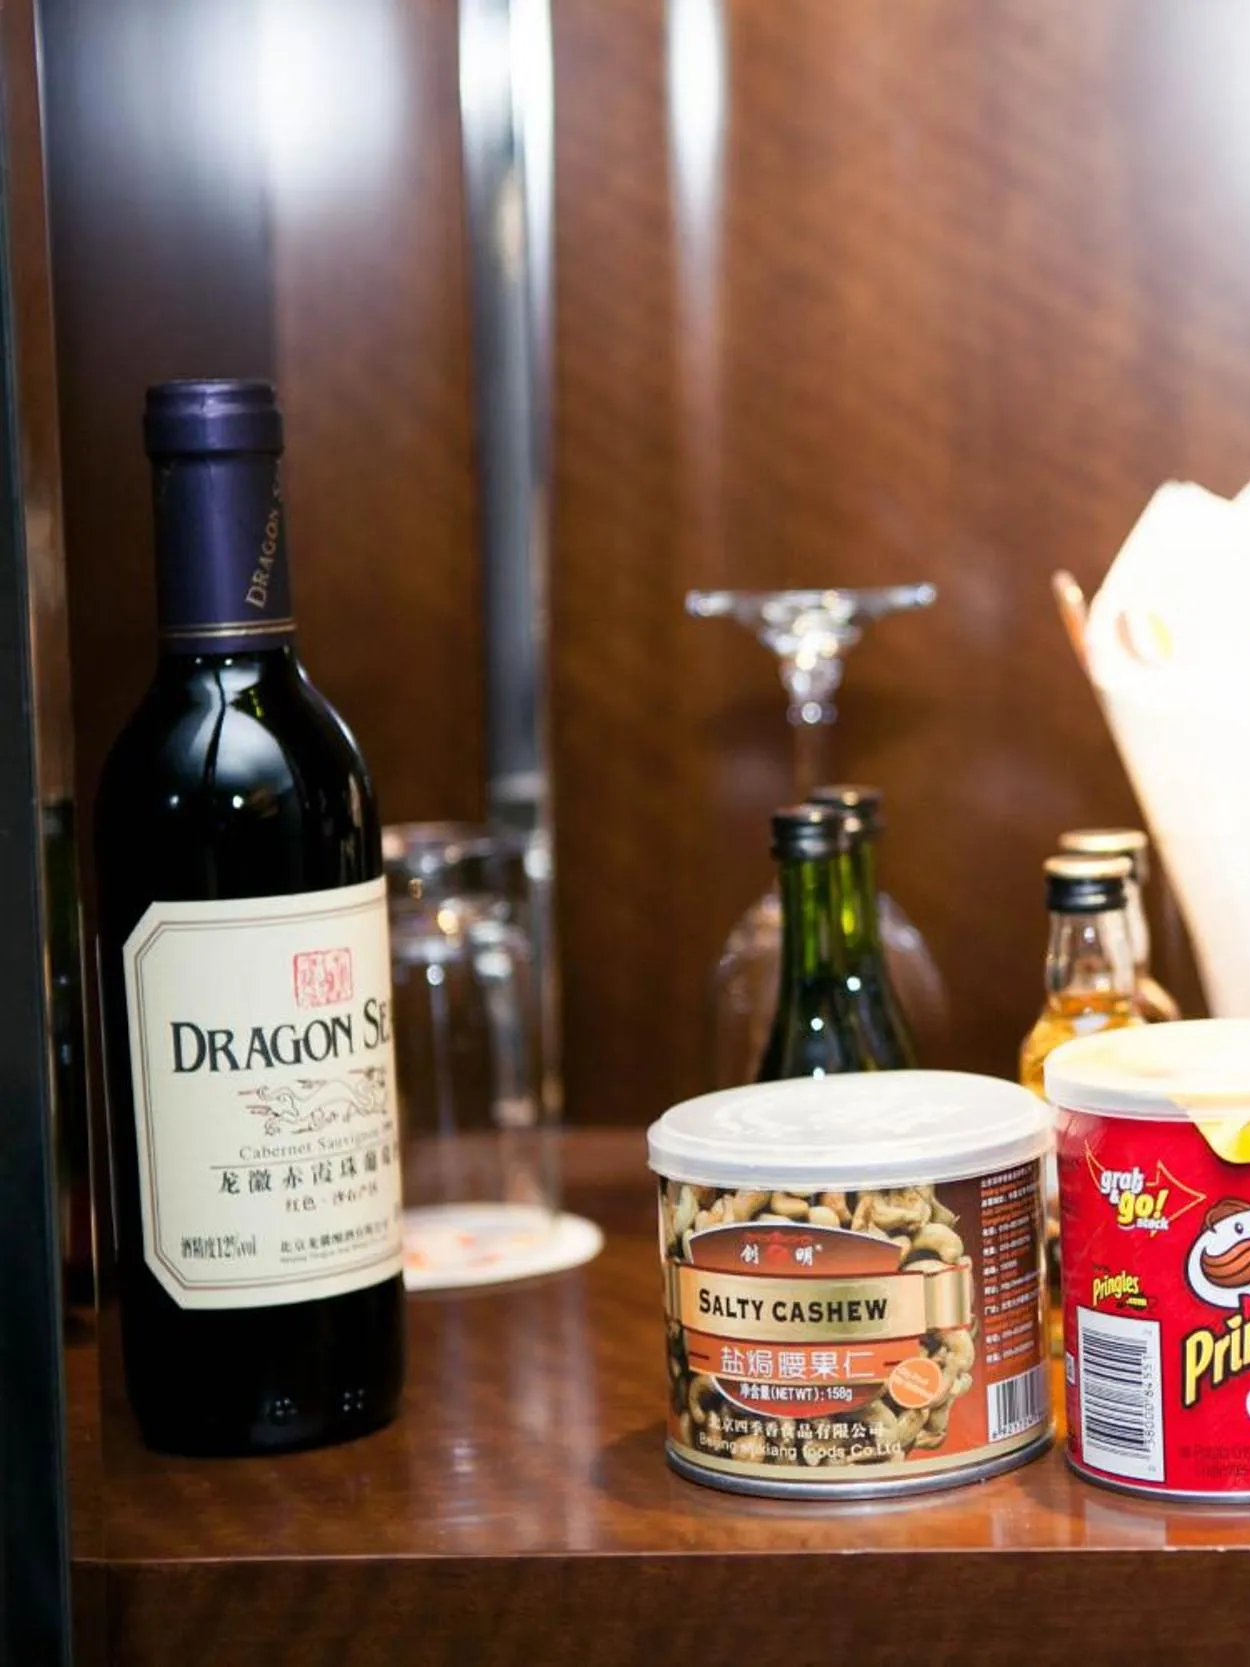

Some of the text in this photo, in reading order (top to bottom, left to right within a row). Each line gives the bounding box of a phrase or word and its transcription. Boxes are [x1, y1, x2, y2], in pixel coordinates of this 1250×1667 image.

[244, 509, 279, 609] DRAGON
[170, 1013, 353, 1074] DRAGON
[239, 1140, 312, 1160] Cabernet
[219, 1142, 399, 1195] 龙徽赤霞珠葡萄
[1100, 1166, 1145, 1194] grab
[1118, 1189, 1169, 1225] go!
[699, 1288, 887, 1322] SALTY CASHEW
[1093, 1270, 1139, 1307] Pringles
[721, 1345, 876, 1380] 盐焗腰果仁
